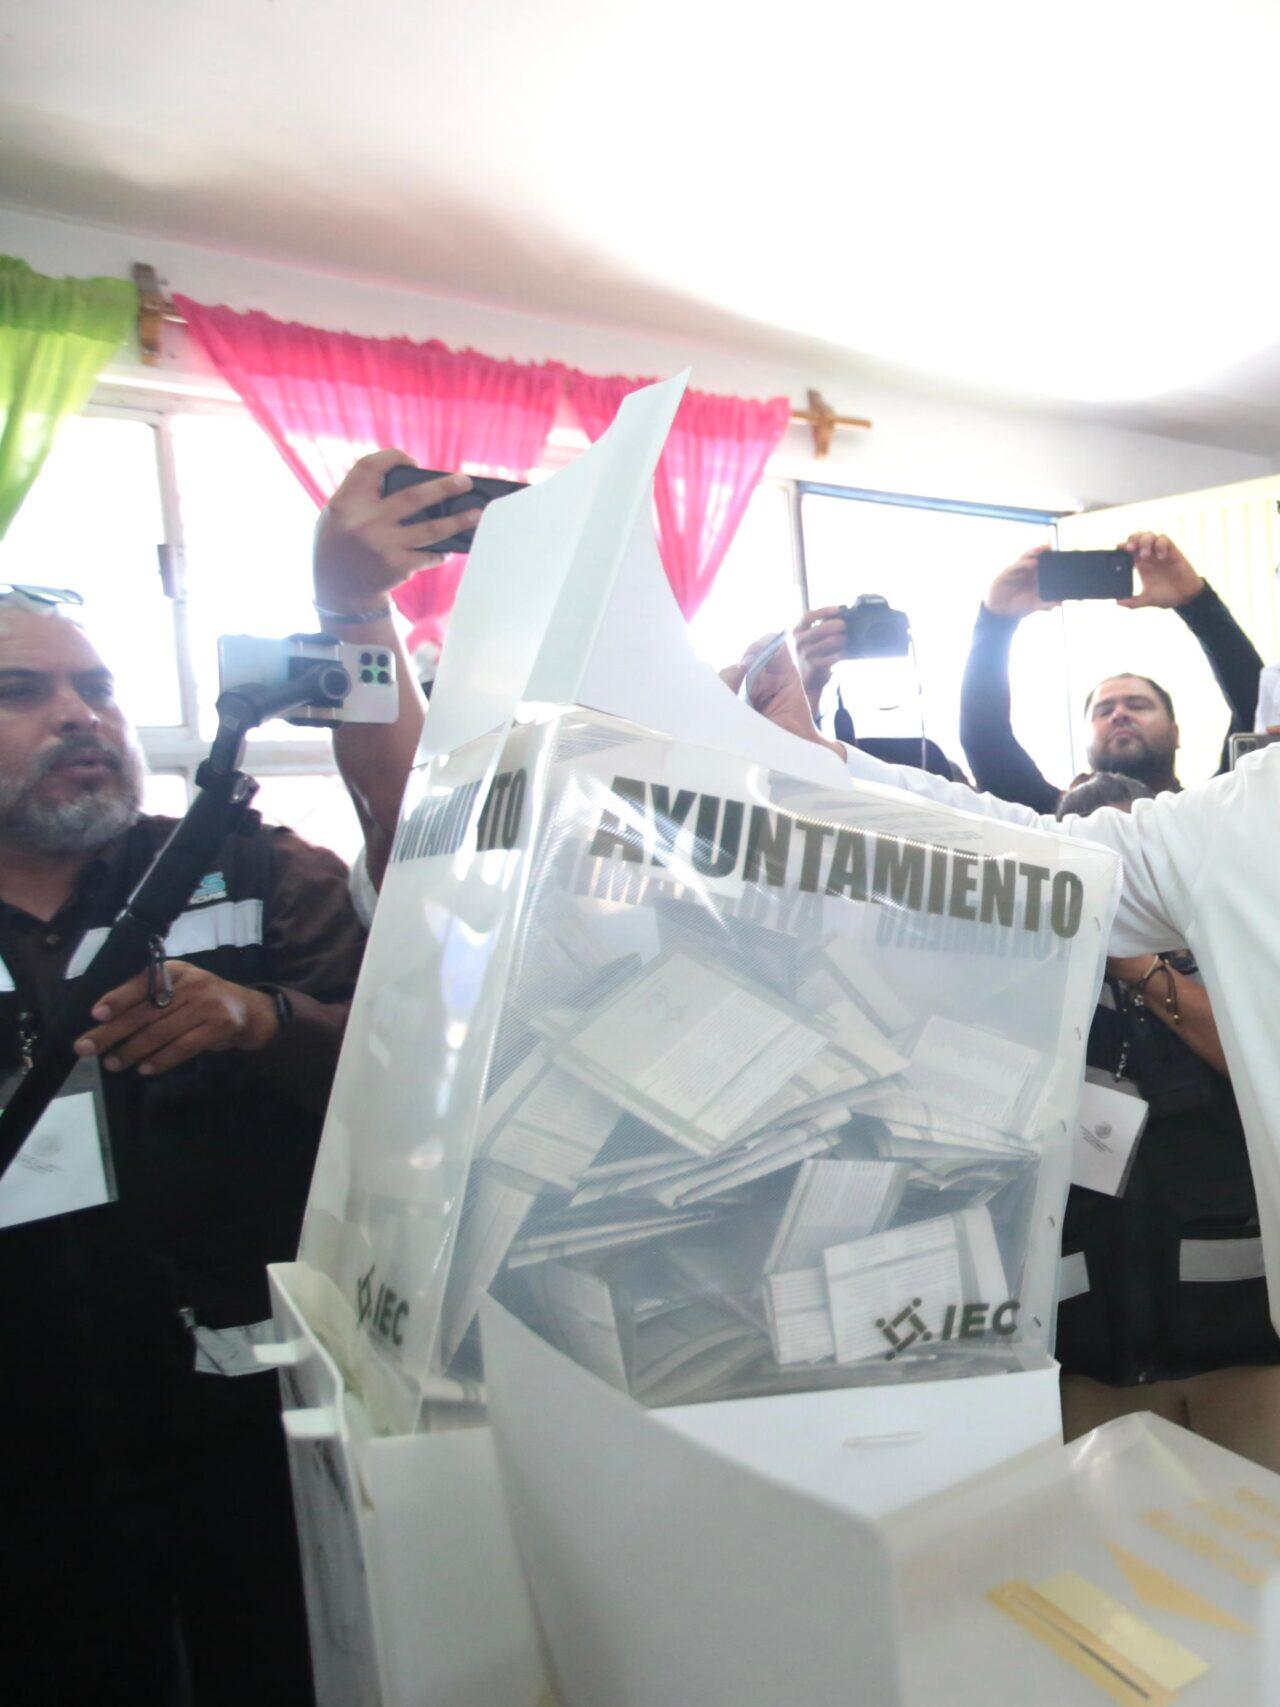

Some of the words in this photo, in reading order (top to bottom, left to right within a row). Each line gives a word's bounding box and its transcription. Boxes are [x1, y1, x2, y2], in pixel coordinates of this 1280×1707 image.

[589, 775, 1084, 940] AYUNTAMIENTO
[373, 1282, 410, 1347] IEC
[940, 1300, 1021, 1341] IEC
